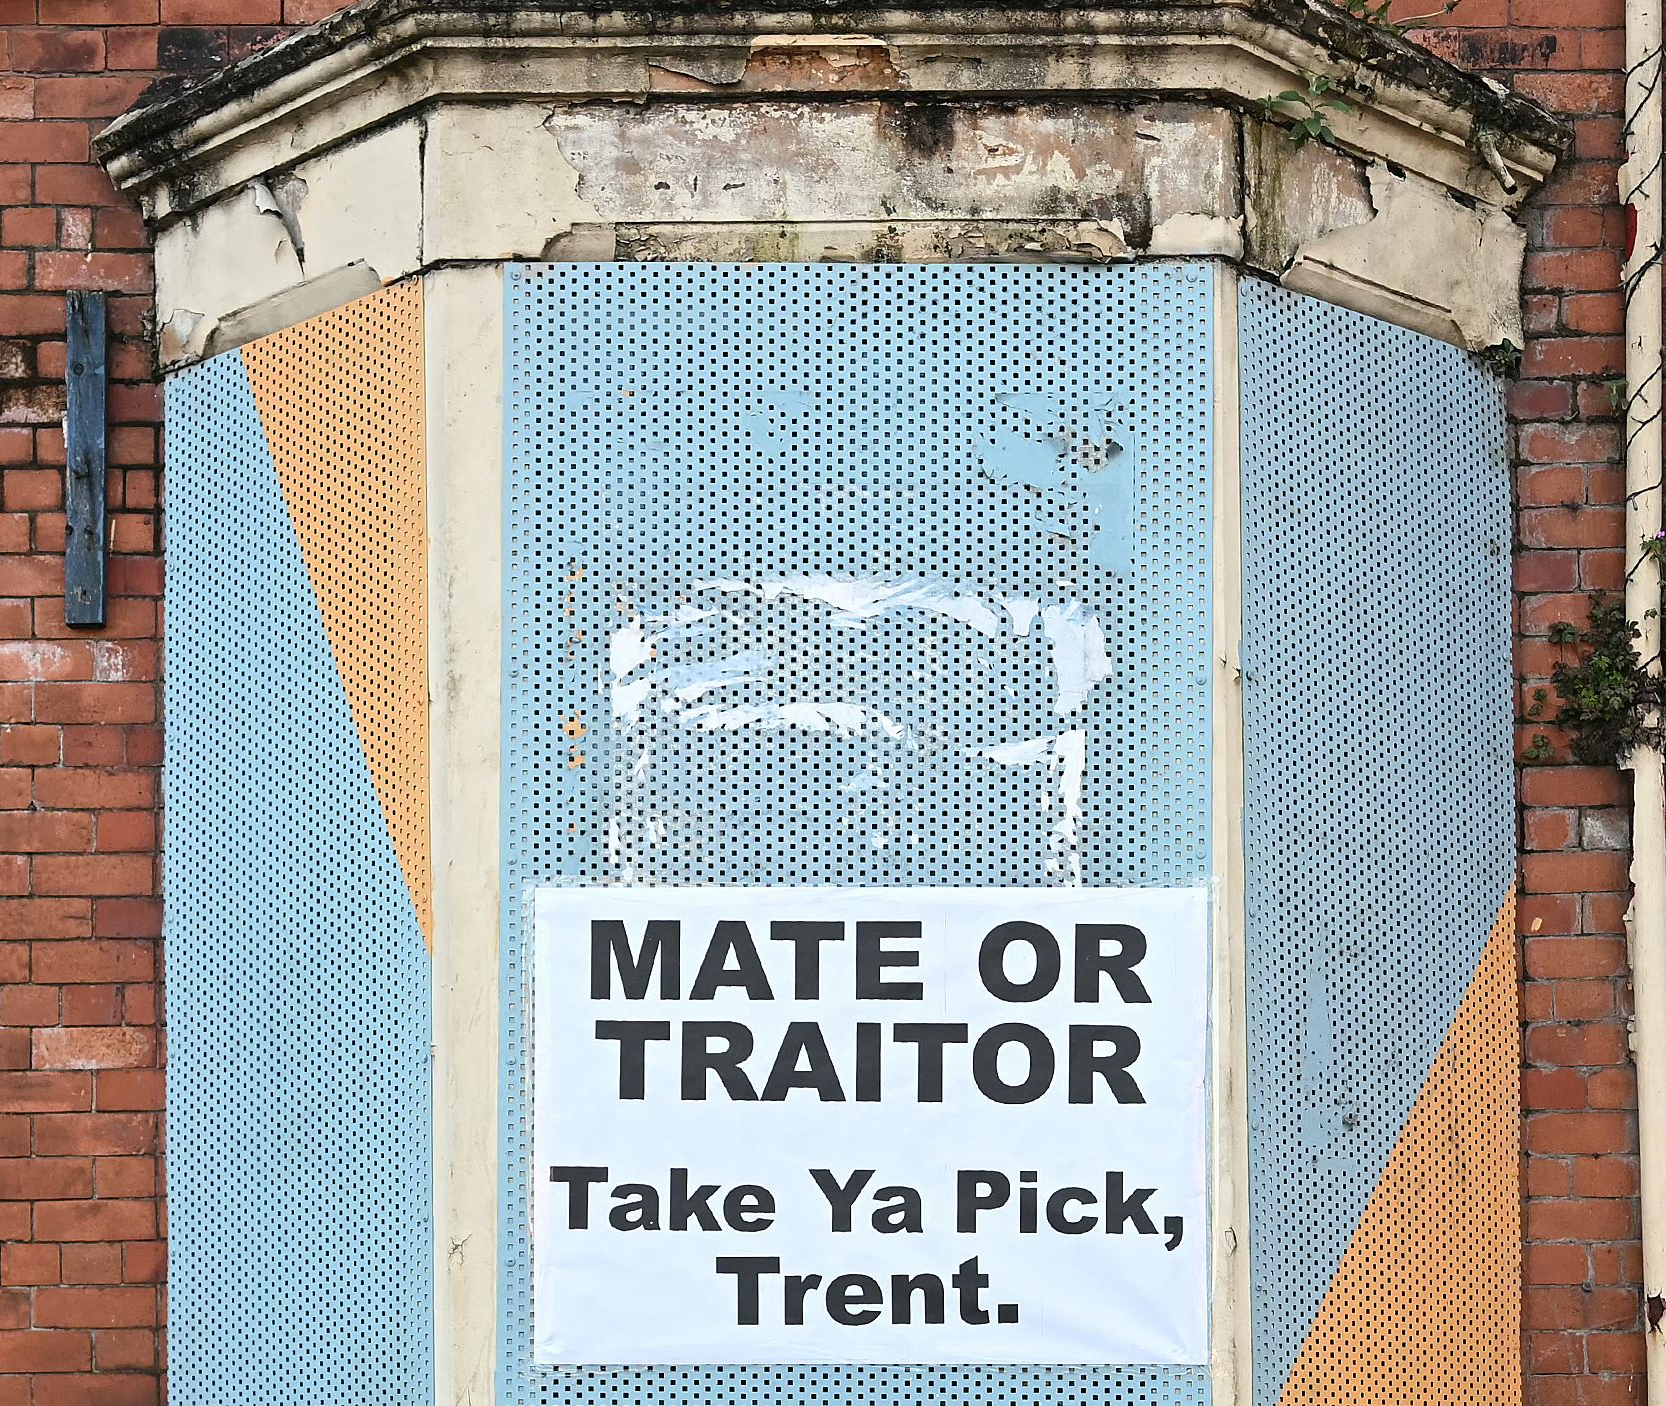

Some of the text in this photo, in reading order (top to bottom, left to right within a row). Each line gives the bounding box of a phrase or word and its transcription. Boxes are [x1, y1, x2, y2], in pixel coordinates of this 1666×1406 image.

[590, 919, 1153, 1004] MATE OR
[594, 1019, 1147, 1105] TRAITOR
[549, 1165, 1184, 1252] Take Ya Pick,
[715, 1255, 1019, 1327] Trent.
